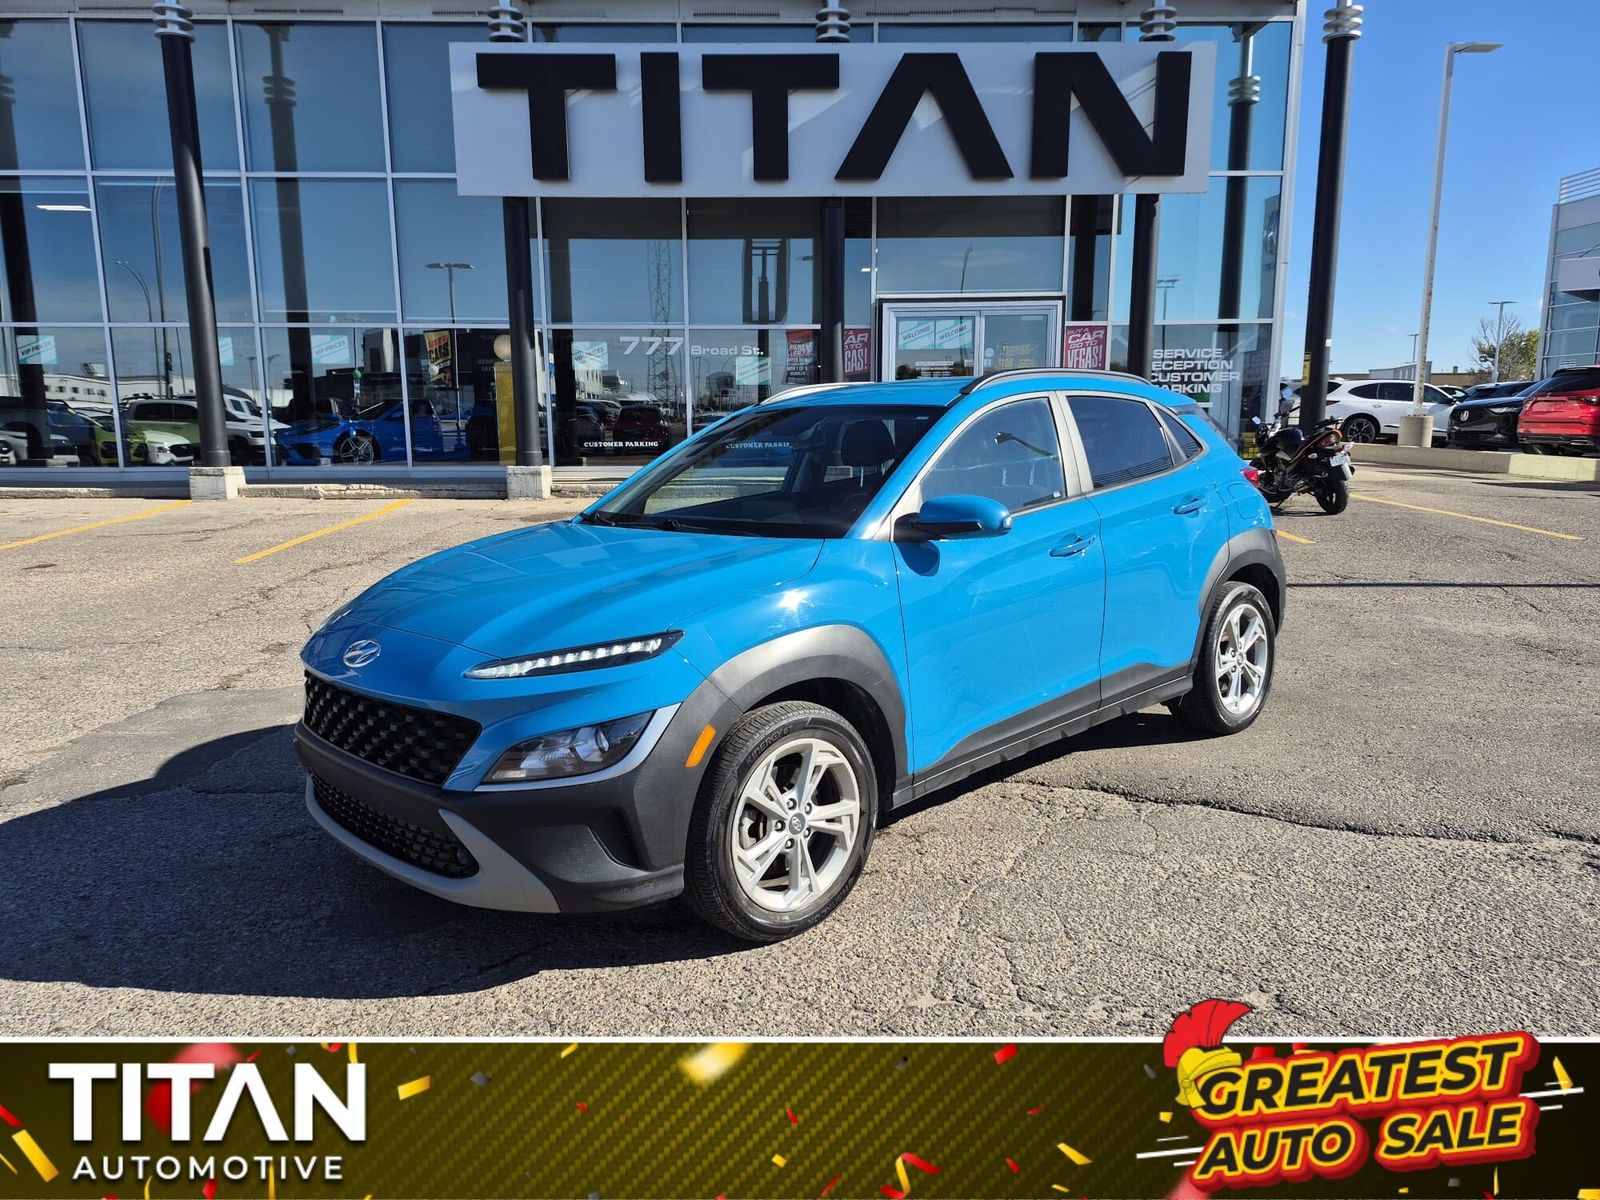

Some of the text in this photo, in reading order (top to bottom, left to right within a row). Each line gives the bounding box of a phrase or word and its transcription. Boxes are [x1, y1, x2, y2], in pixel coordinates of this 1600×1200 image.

[475, 52, 1192, 182] TITAN
[844, 333, 869, 344] AR
[903, 325, 930, 342] WELCOME
[939, 324, 968, 341] WELCOME
[1068, 330, 1105, 344] CAR
[619, 336, 684, 355] 777
[691, 346, 764, 356] Broad St.
[845, 347, 867, 373] GAS!
[1068, 345, 1103, 369] VEGAS!
[1152, 348, 1223, 359] SERVICE
[1151, 360, 1233, 370] ECEPTION
[1150, 372, 1240, 382] CUSTOMER
[1155, 383, 1222, 393] ARKING
